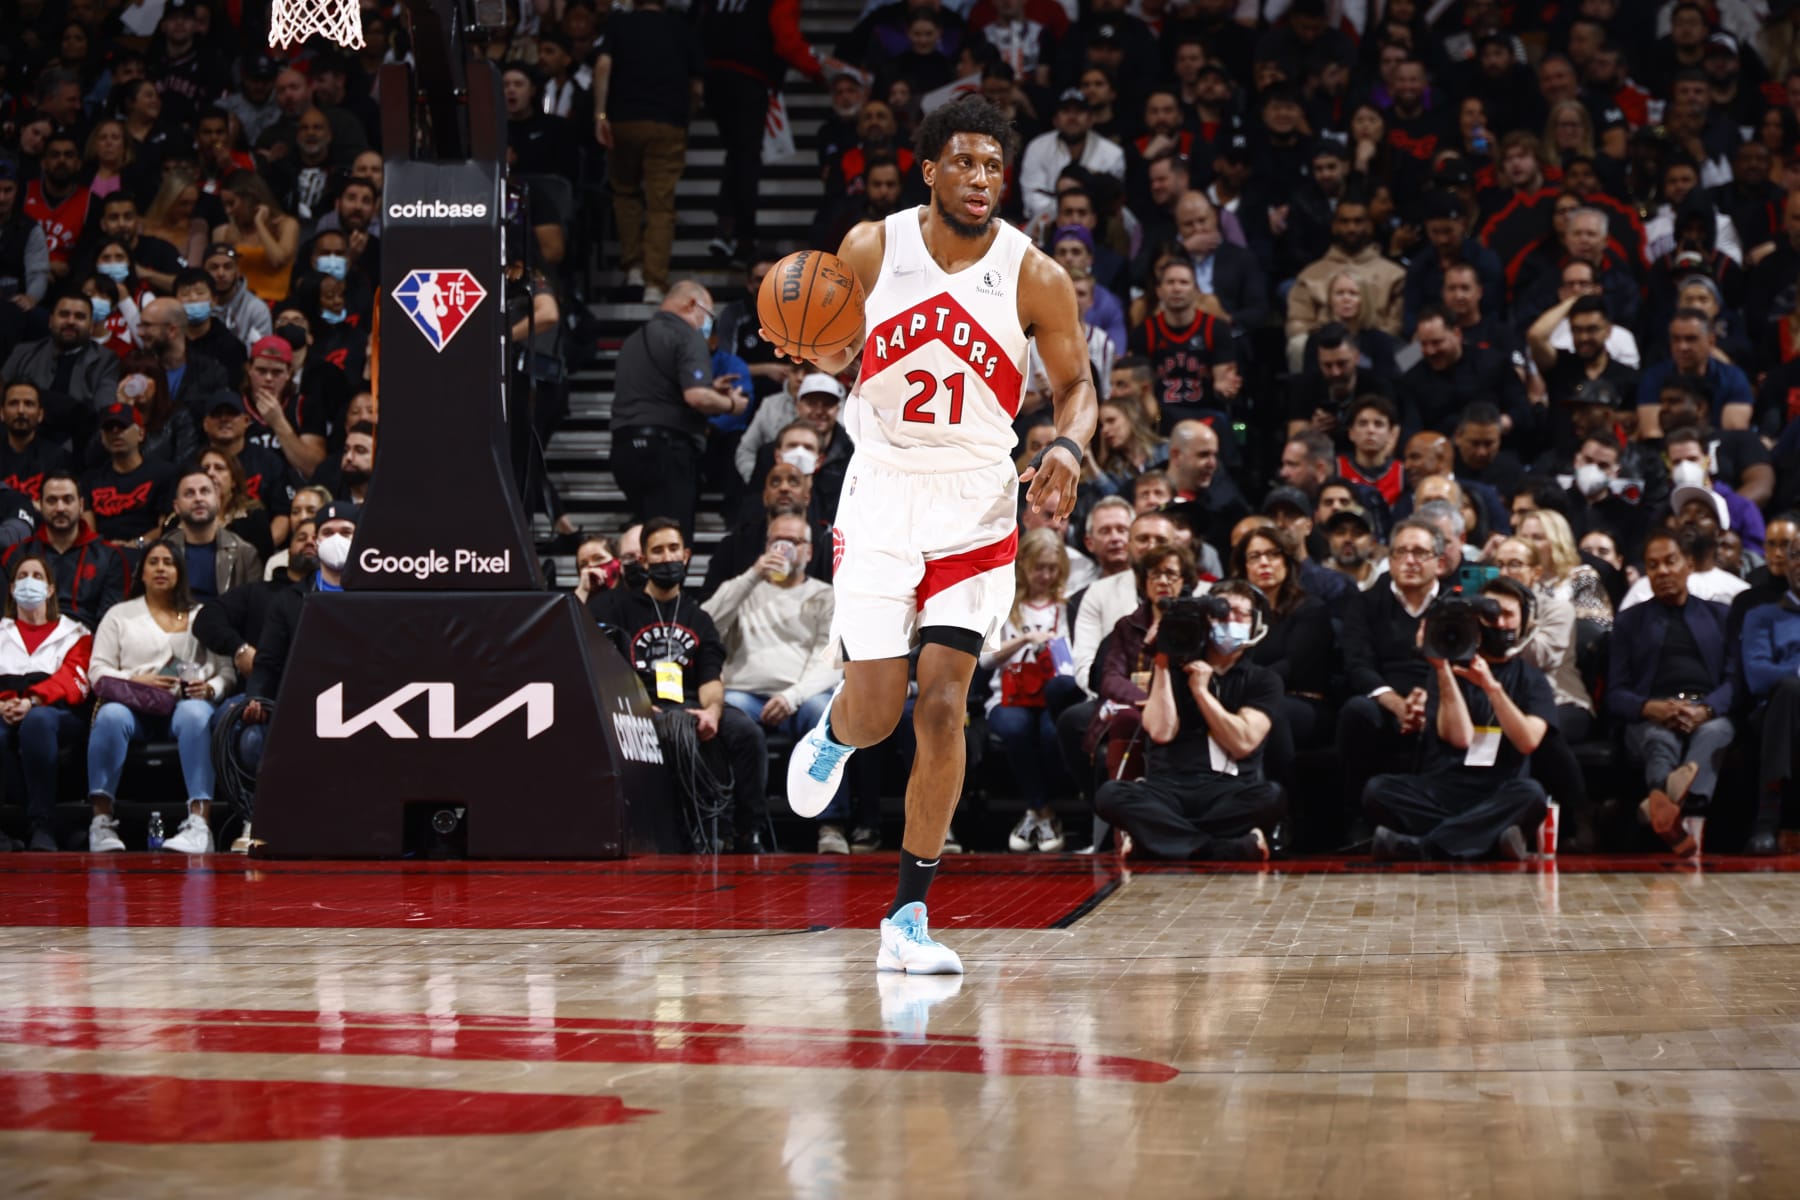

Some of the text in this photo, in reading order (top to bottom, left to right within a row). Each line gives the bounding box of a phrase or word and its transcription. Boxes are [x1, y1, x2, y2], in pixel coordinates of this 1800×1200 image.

[388, 200, 488, 218] coinbase
[447, 282, 466, 306] 75
[875, 307, 998, 378] RAPTORS
[903, 369, 965, 425] 21
[1162, 377, 1204, 403] 23
[359, 547, 510, 580] Google Pixel
